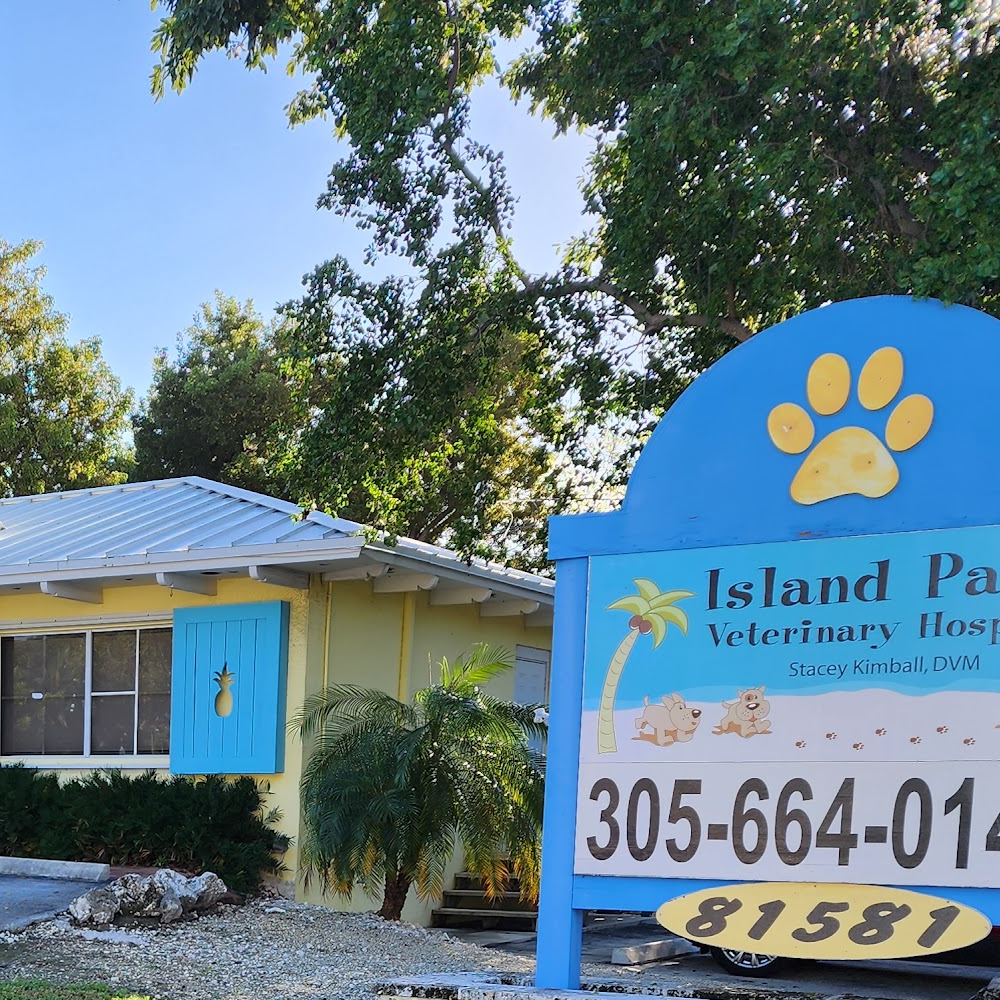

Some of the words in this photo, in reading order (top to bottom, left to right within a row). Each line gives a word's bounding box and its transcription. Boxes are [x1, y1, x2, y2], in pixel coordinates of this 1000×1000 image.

[705, 559, 892, 612] Island
[922, 552, 1000, 599] Pa
[707, 619, 902, 650] Veterinary
[789, 660, 848, 680] Stacey
[853, 657, 930, 676] Kimball,
[933, 655, 981, 672] DVM
[685, 897, 961, 949] 81581
